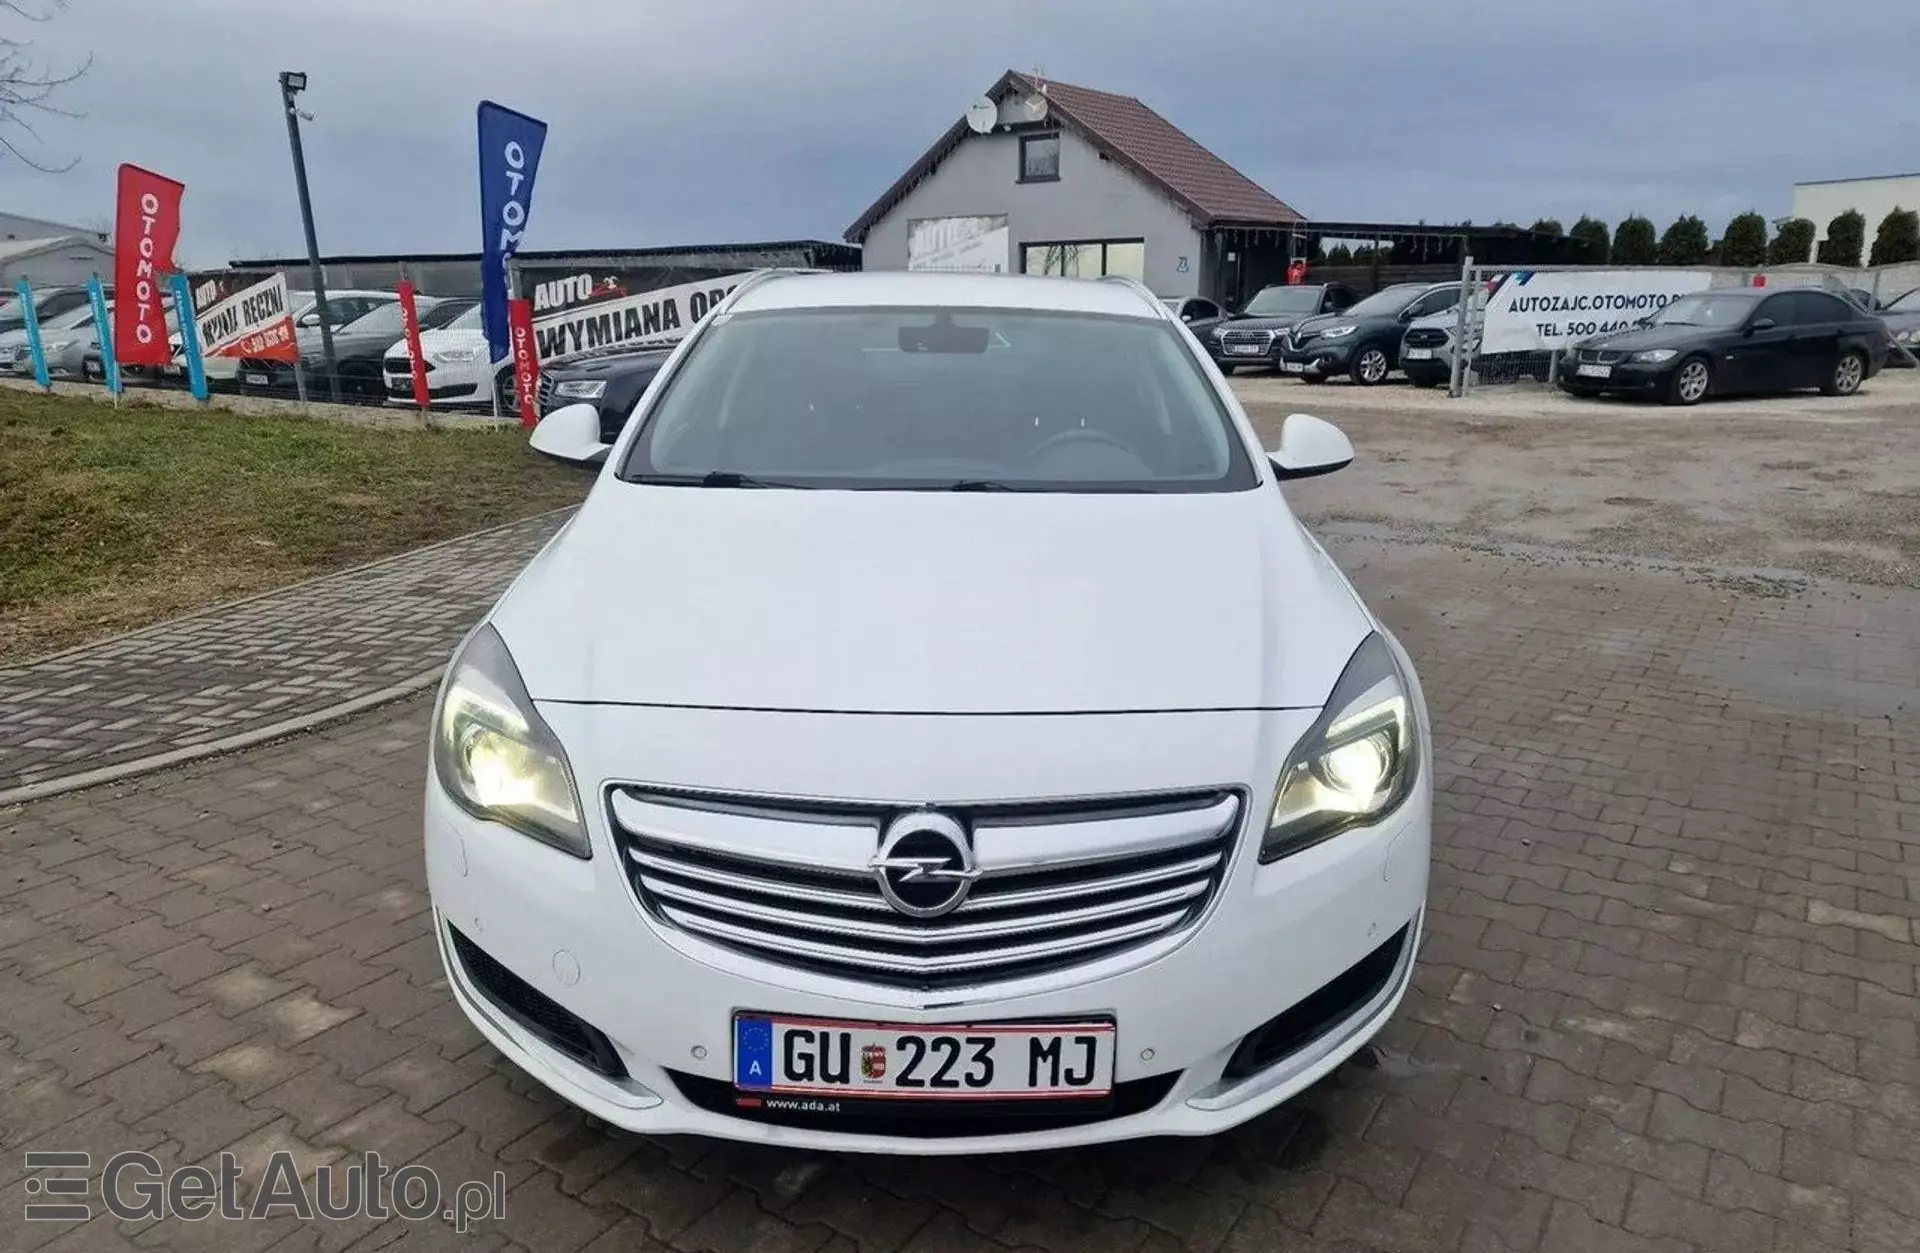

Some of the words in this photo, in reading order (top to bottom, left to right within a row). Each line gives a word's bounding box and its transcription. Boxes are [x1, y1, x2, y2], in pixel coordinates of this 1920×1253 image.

[137, 193, 158, 343] OTOMOTO
[534, 273, 592, 311] AUTO
[537, 298, 681, 359] WYMIANA
[690, 285, 737, 324] OP
[1537, 323, 1563, 336] TEL.
[1568, 322, 1596, 336] 500
[749, 1060, 762, 1076] A
[783, 1029, 851, 1084] GU
[895, 1035, 996, 1088] 223
[1029, 1036, 1097, 1088] MJ
[767, 1100, 840, 1112] www.ada.at
